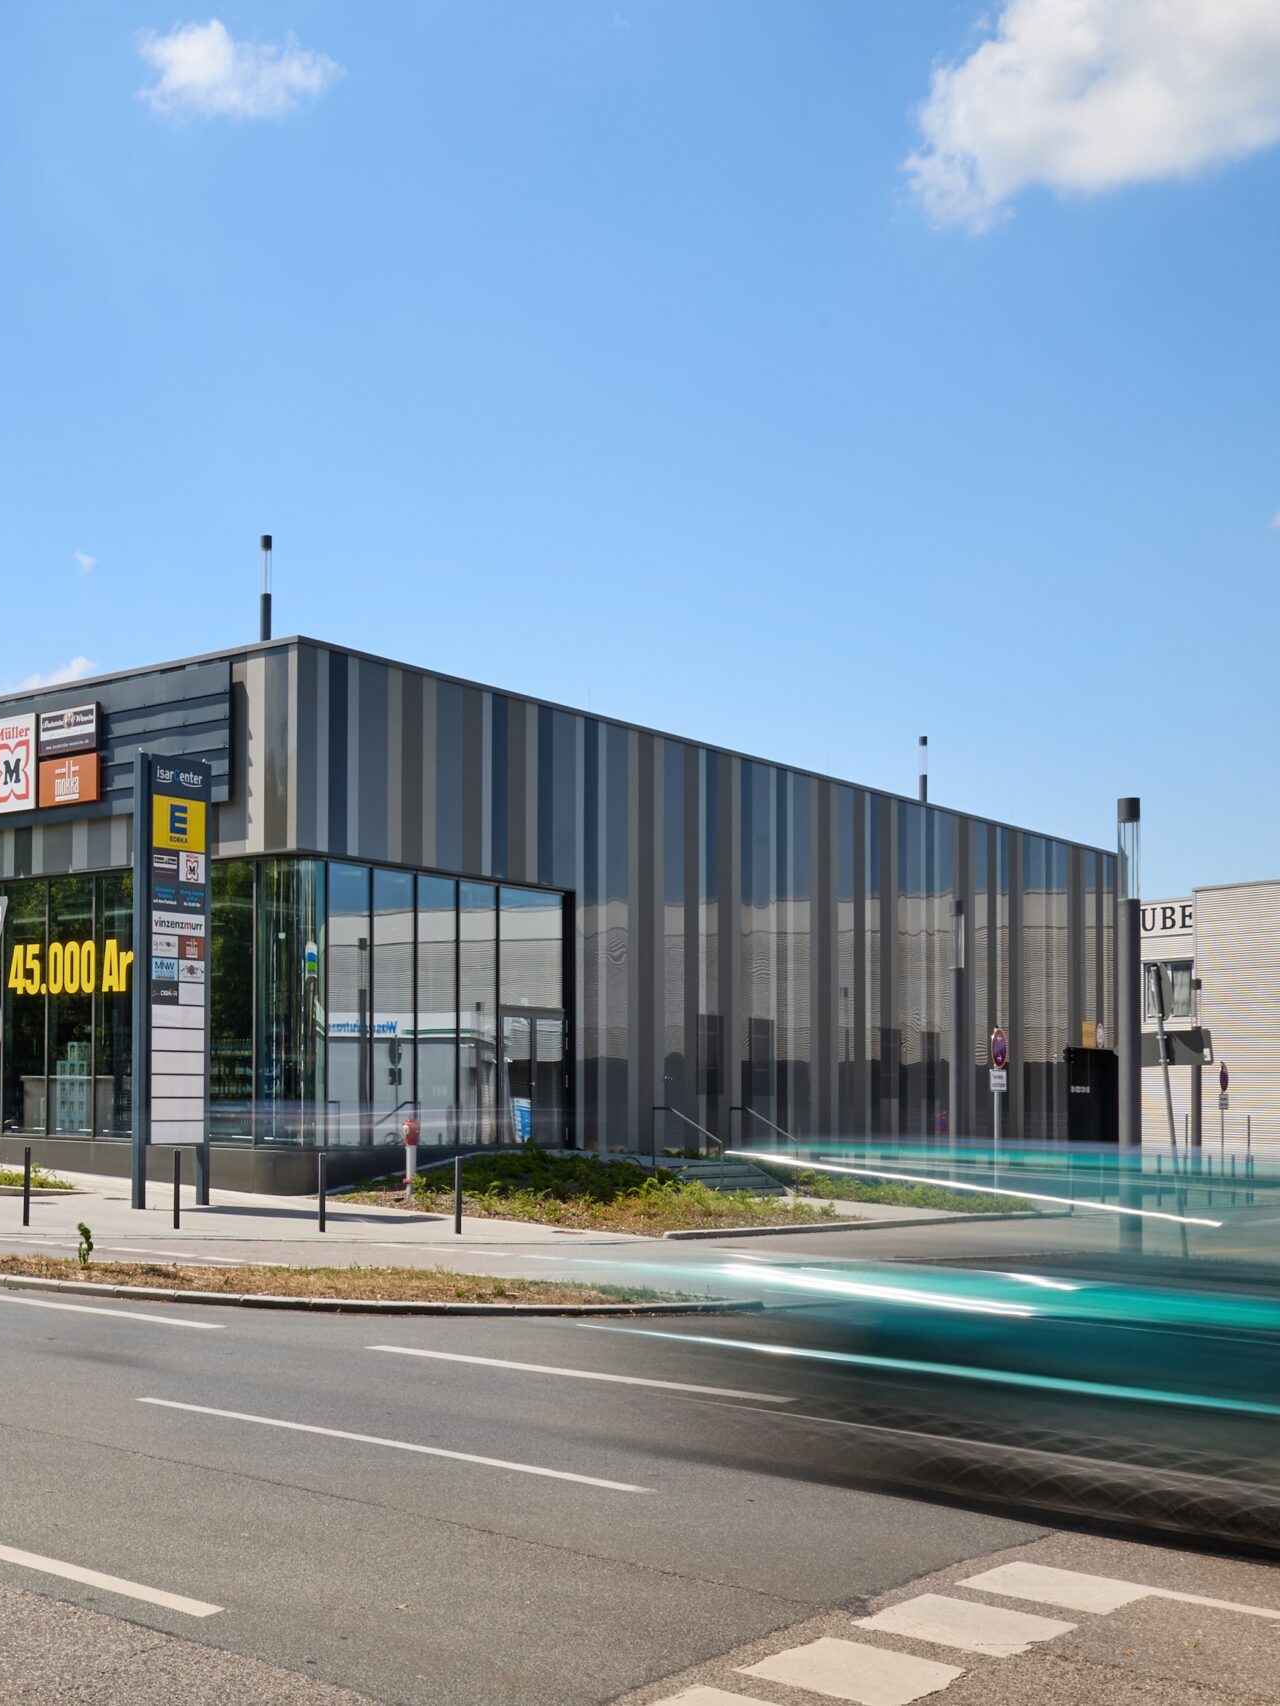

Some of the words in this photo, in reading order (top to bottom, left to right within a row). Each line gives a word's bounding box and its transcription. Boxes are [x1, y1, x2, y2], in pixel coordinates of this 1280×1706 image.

[3, 758, 21, 786] M
[55, 760, 80, 796] mokka
[156, 765, 203, 785] isarCenter
[154, 917, 203, 930] vinzenzmurr
[1140, 905, 1192, 932] UBE
[8, 940, 96, 995] 45.000
